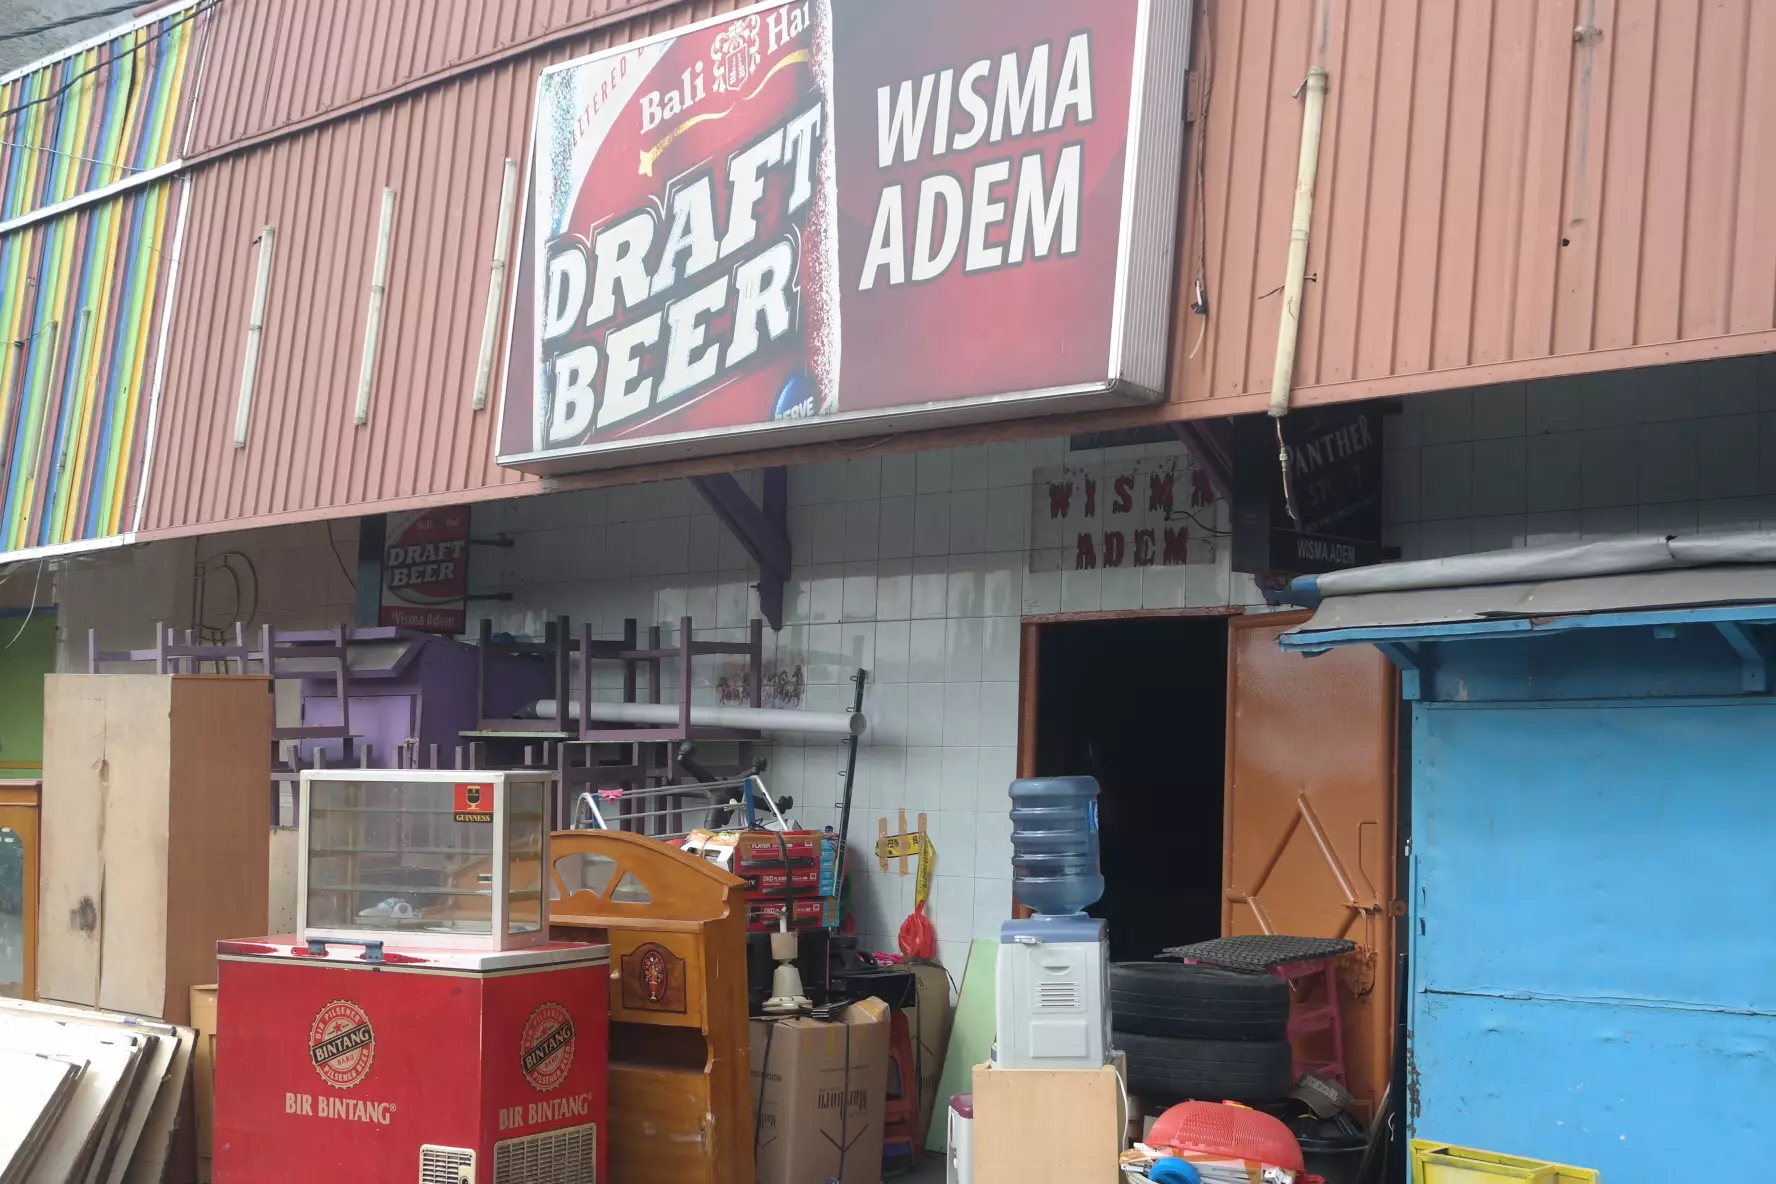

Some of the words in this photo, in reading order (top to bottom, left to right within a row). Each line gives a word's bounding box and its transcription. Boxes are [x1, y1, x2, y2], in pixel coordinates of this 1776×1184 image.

[639, 61, 705, 134] Bali
[877, 33, 1093, 168] WISMA
[543, 102, 822, 340] DRAFT
[858, 145, 1081, 291] ADEM
[549, 240, 793, 443] BEER
[1048, 469, 1215, 519] WISMA
[387, 540, 465, 567] DRAFT
[1076, 524, 1190, 571] ADEM
[1297, 538, 1328, 560] WISMA
[1327, 543, 1356, 565] ADEM
[391, 561, 454, 587] BEER
[391, 610, 424, 626] Wisma
[426, 612, 455, 628] Adem
[456, 814, 490, 822] GUINNESS
[315, 1022, 325, 1040] BIR
[324, 1007, 361, 1023] PILSENER
[315, 1027, 369, 1062] BINTANG
[525, 1025, 571, 1069] BINTANG
[323, 1065, 357, 1082] PILSENER
[356, 1048, 369, 1072] BEER
[285, 1092, 313, 1116] BIR
[499, 1105, 524, 1131] BIR
